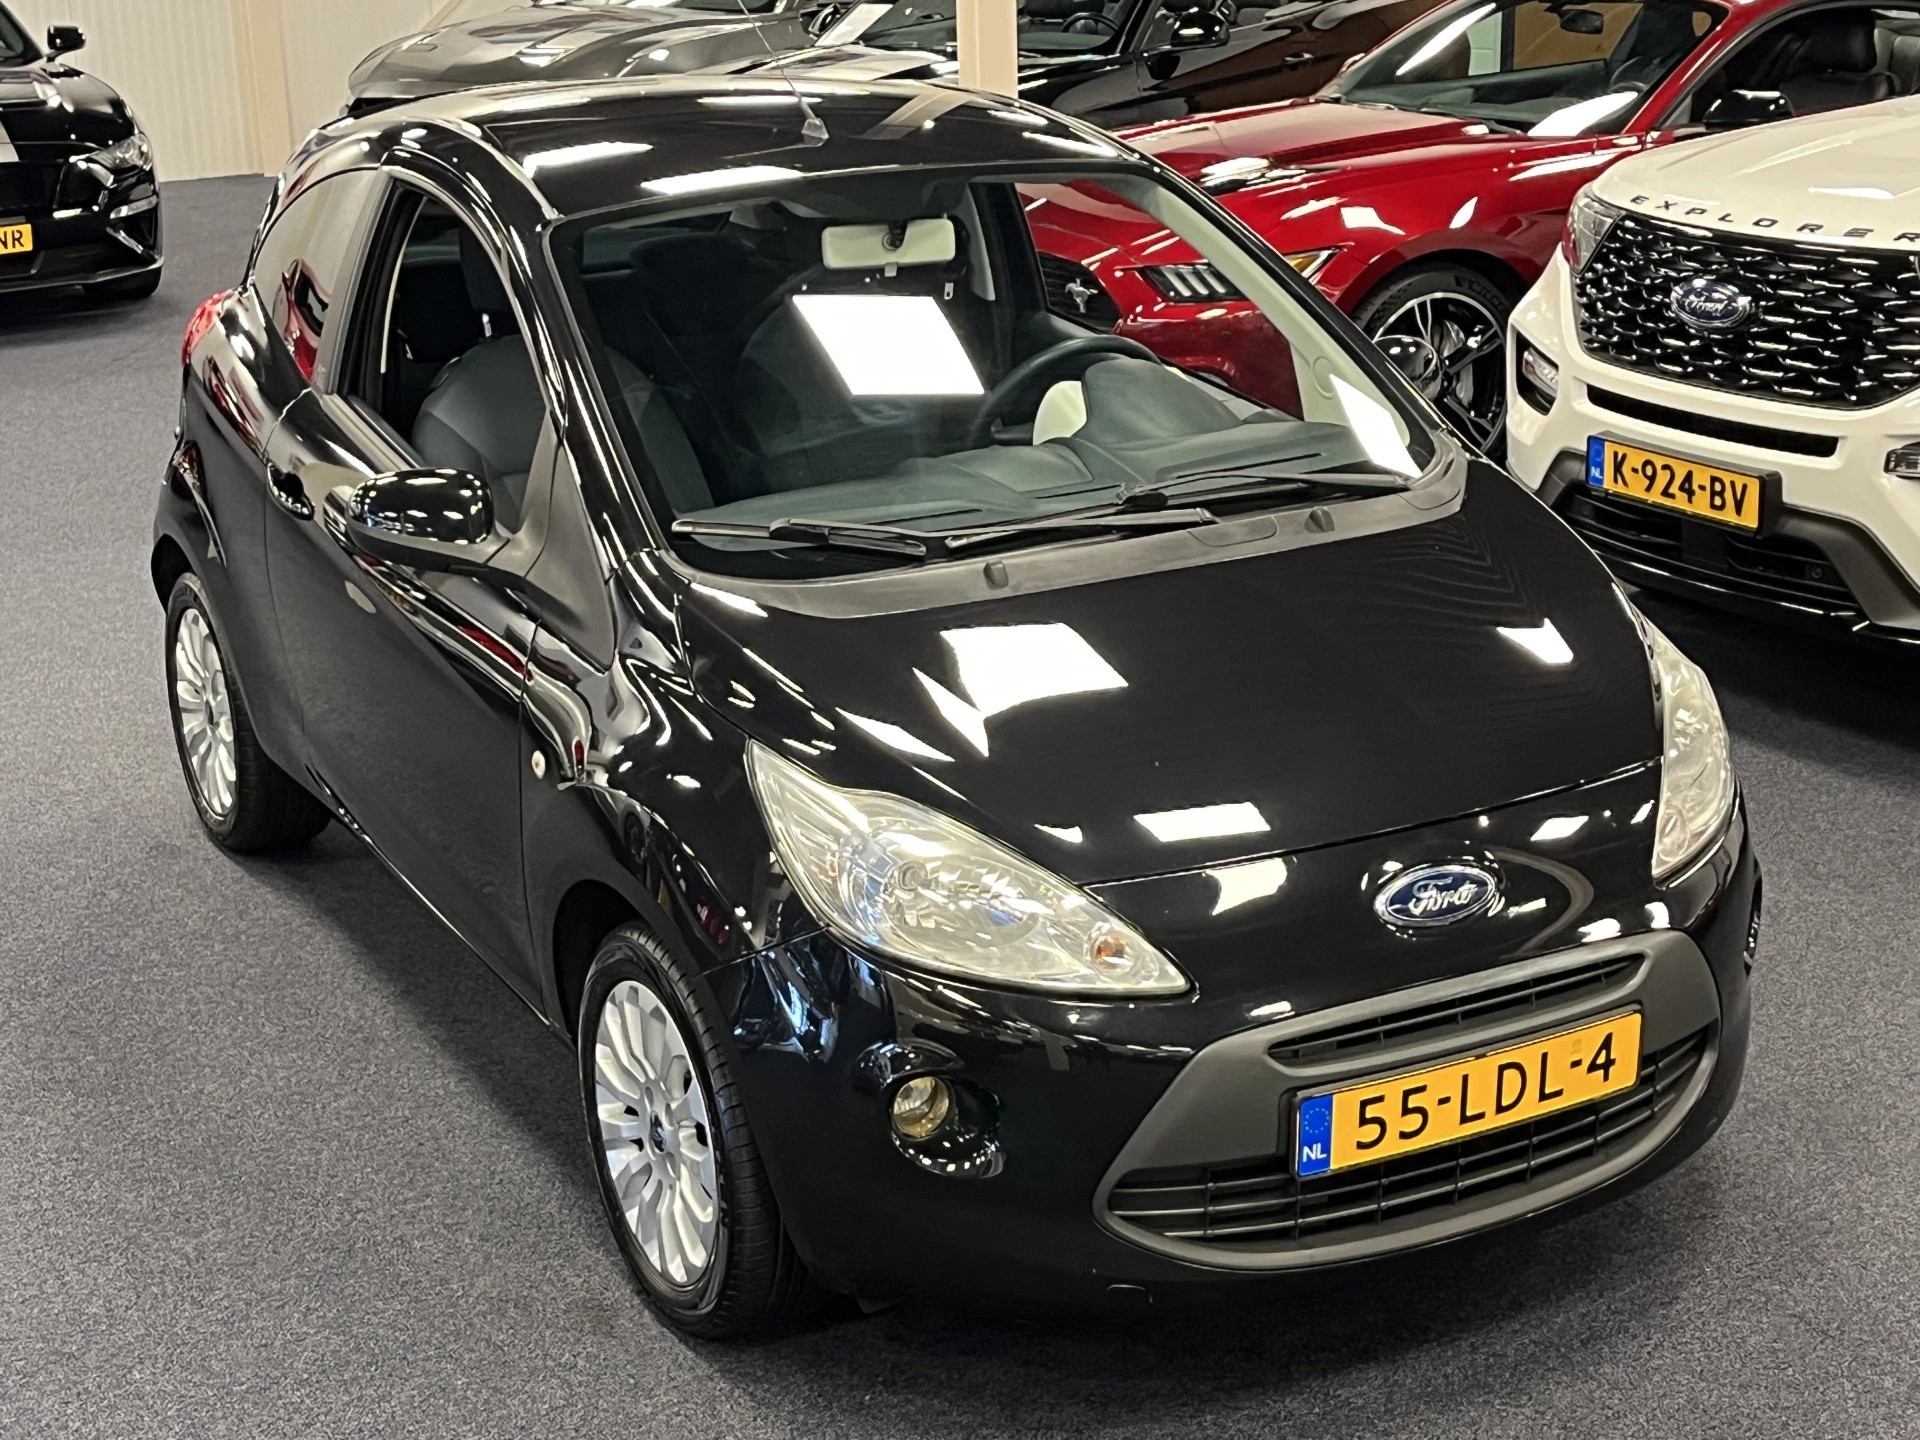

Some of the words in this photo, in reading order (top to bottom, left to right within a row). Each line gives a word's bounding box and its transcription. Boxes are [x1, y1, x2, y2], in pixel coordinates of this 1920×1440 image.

[1630, 194, 1920, 242] EXPLORER
[1685, 288, 1731, 316] Ford
[1591, 466, 1603, 479] NL
[1613, 450, 1748, 517] K-924-BV
[1408, 876, 1478, 916] Ford
[1355, 1032, 1617, 1151] 55-LDL-4
[1302, 1142, 1328, 1163] NL
